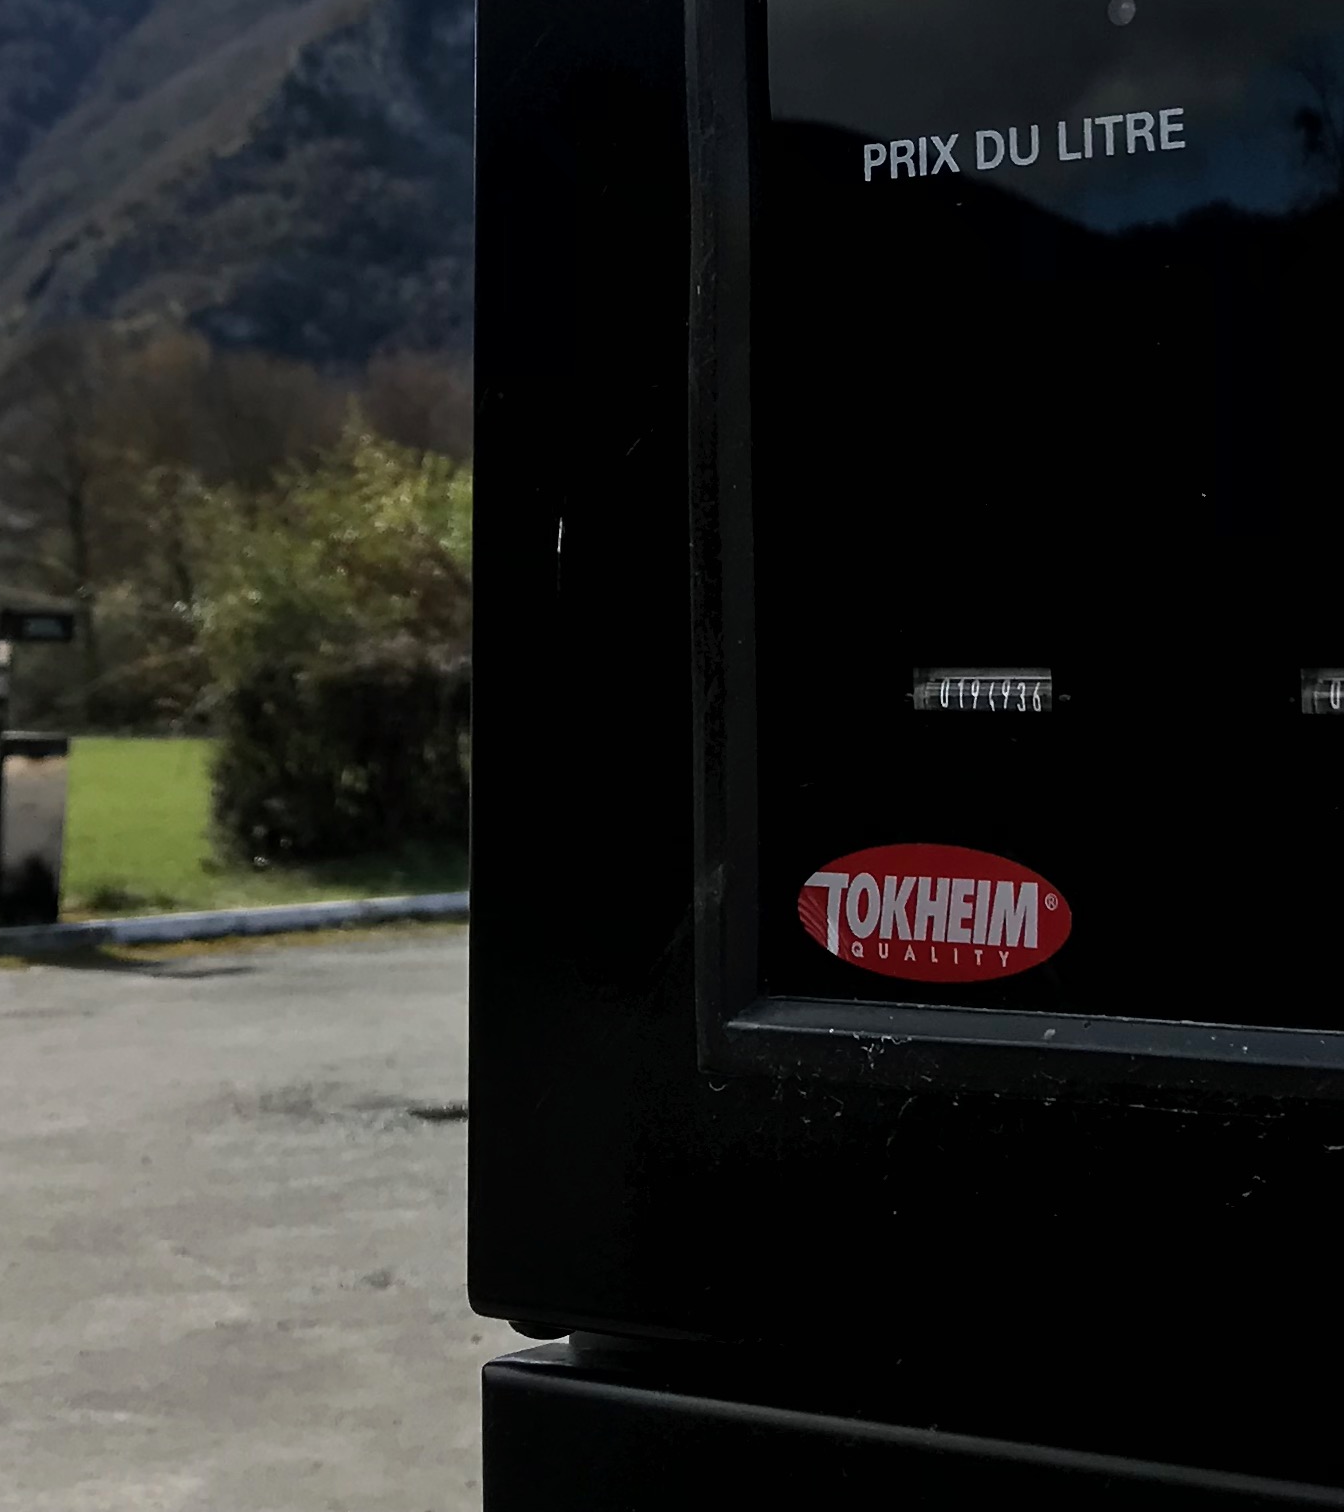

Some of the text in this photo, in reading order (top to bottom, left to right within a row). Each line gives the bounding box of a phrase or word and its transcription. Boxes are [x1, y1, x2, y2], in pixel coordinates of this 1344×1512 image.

[863, 107, 1186, 181] PRIX DU LITRE
[852, 942, 1009, 967] QUALITY
